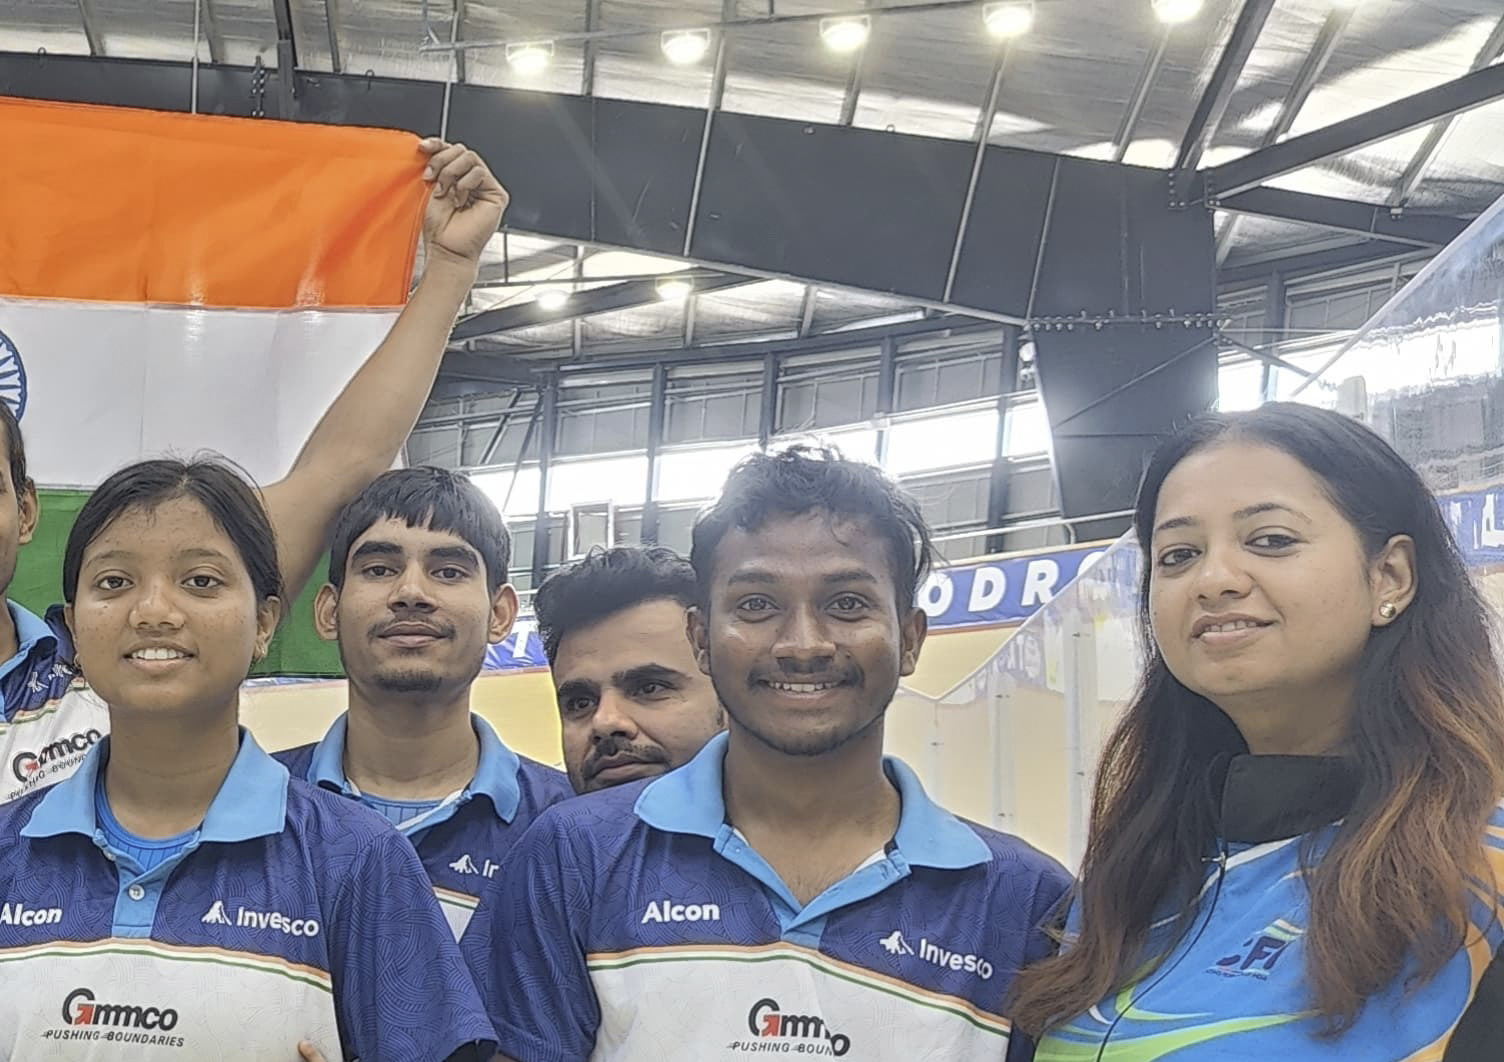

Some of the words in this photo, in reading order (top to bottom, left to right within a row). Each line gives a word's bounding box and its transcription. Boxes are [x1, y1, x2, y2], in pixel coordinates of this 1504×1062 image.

[0, 902, 63, 927] Alcon
[237, 906, 320, 938] Invesco
[641, 901, 721, 924] Alcon
[43, 1028, 100, 1042] PUSHING
[103, 1031, 185, 1048] BOUNDARIES
[730, 1040, 791, 1053] PUSHING
